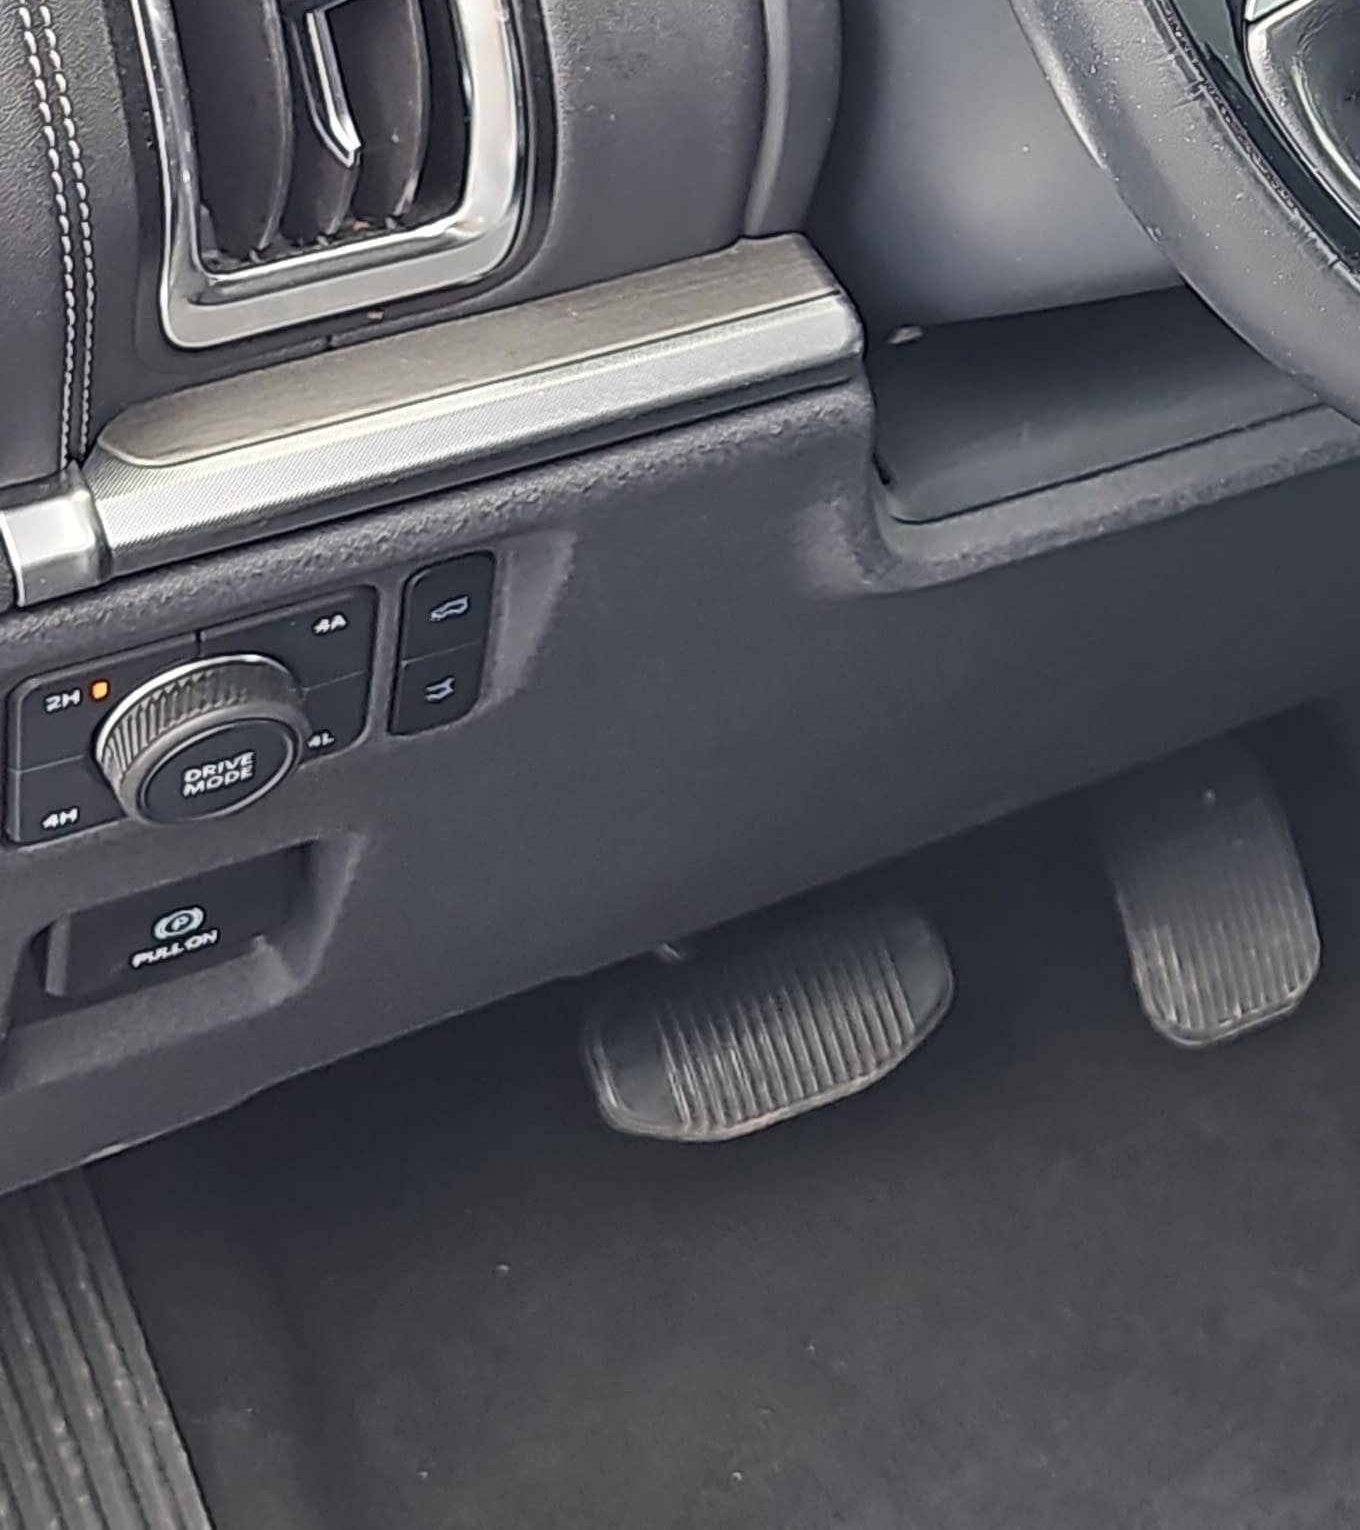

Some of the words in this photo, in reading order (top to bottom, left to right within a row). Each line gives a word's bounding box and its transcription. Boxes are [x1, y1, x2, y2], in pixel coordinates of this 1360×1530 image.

[313, 614, 347, 635] 4A
[45, 689, 81, 712] 2H
[307, 732, 335, 749] 4L
[183, 750, 255, 783] DRIVE
[182, 765, 254, 798] MODE
[42, 807, 79, 829] 4H
[132, 942, 184, 968] PULL
[184, 929, 218, 950] ON
